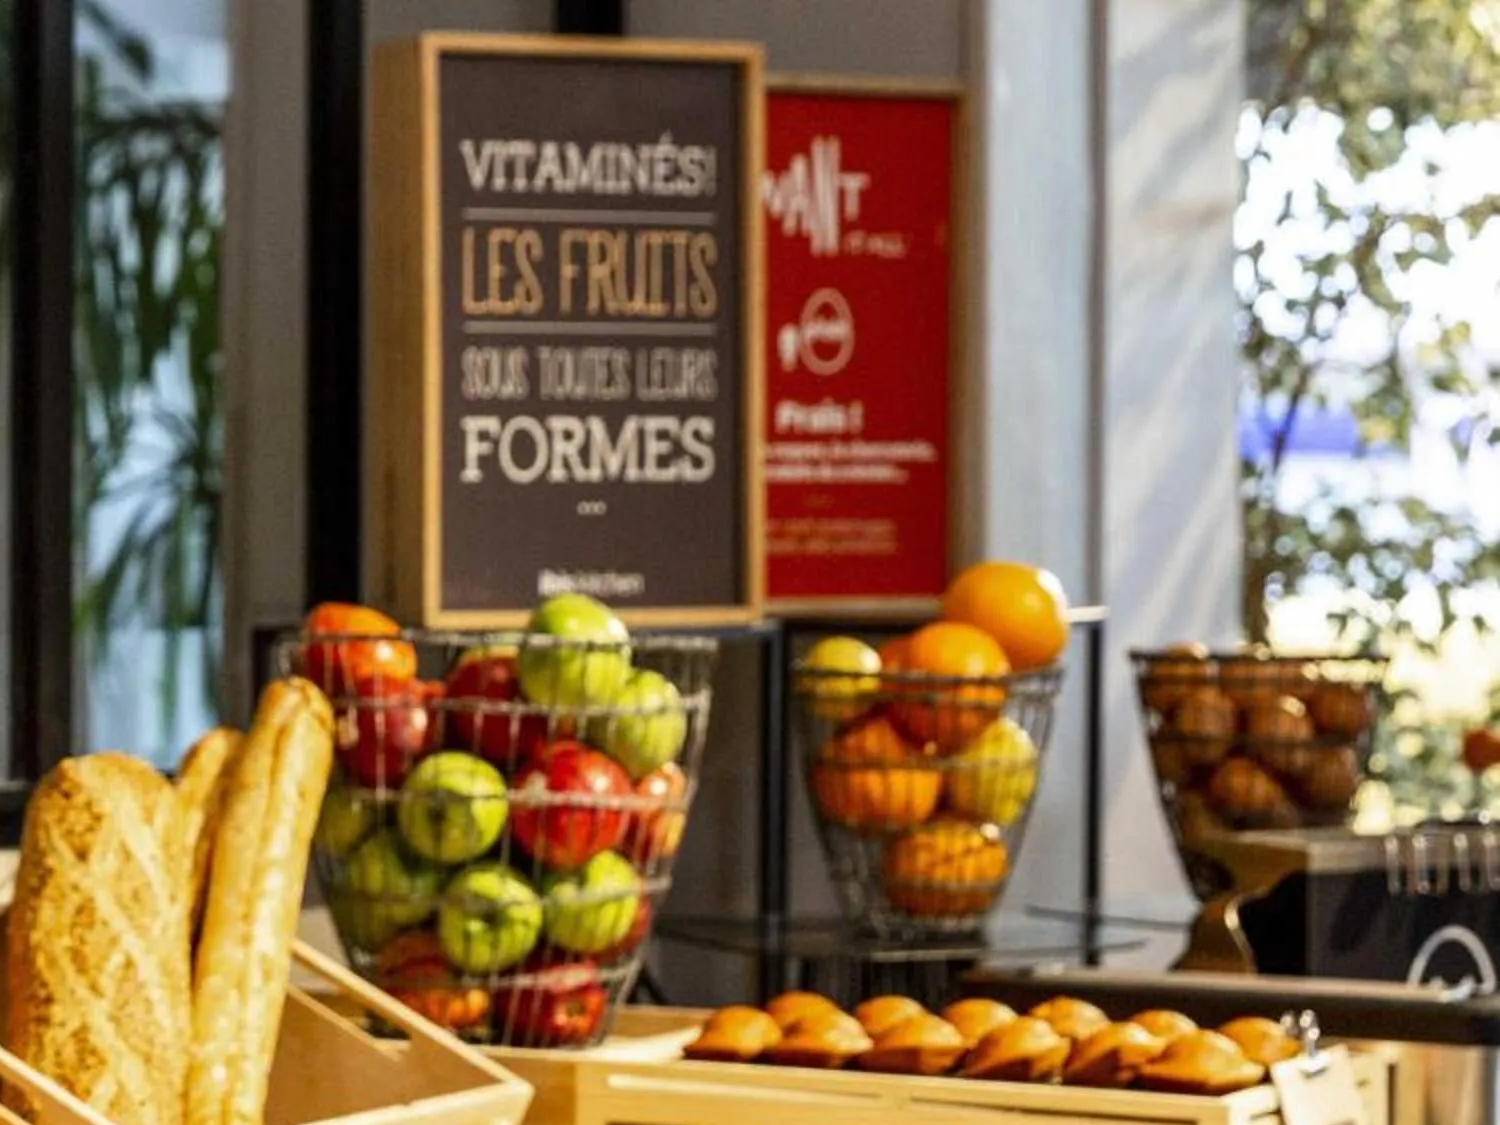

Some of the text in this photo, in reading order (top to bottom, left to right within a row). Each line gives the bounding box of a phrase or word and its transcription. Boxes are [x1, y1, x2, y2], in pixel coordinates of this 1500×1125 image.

[462, 227, 718, 318] LES FRUITS
[461, 345, 719, 402] SOUS TOUTES LEURS
[459, 414, 717, 484] FORMES
